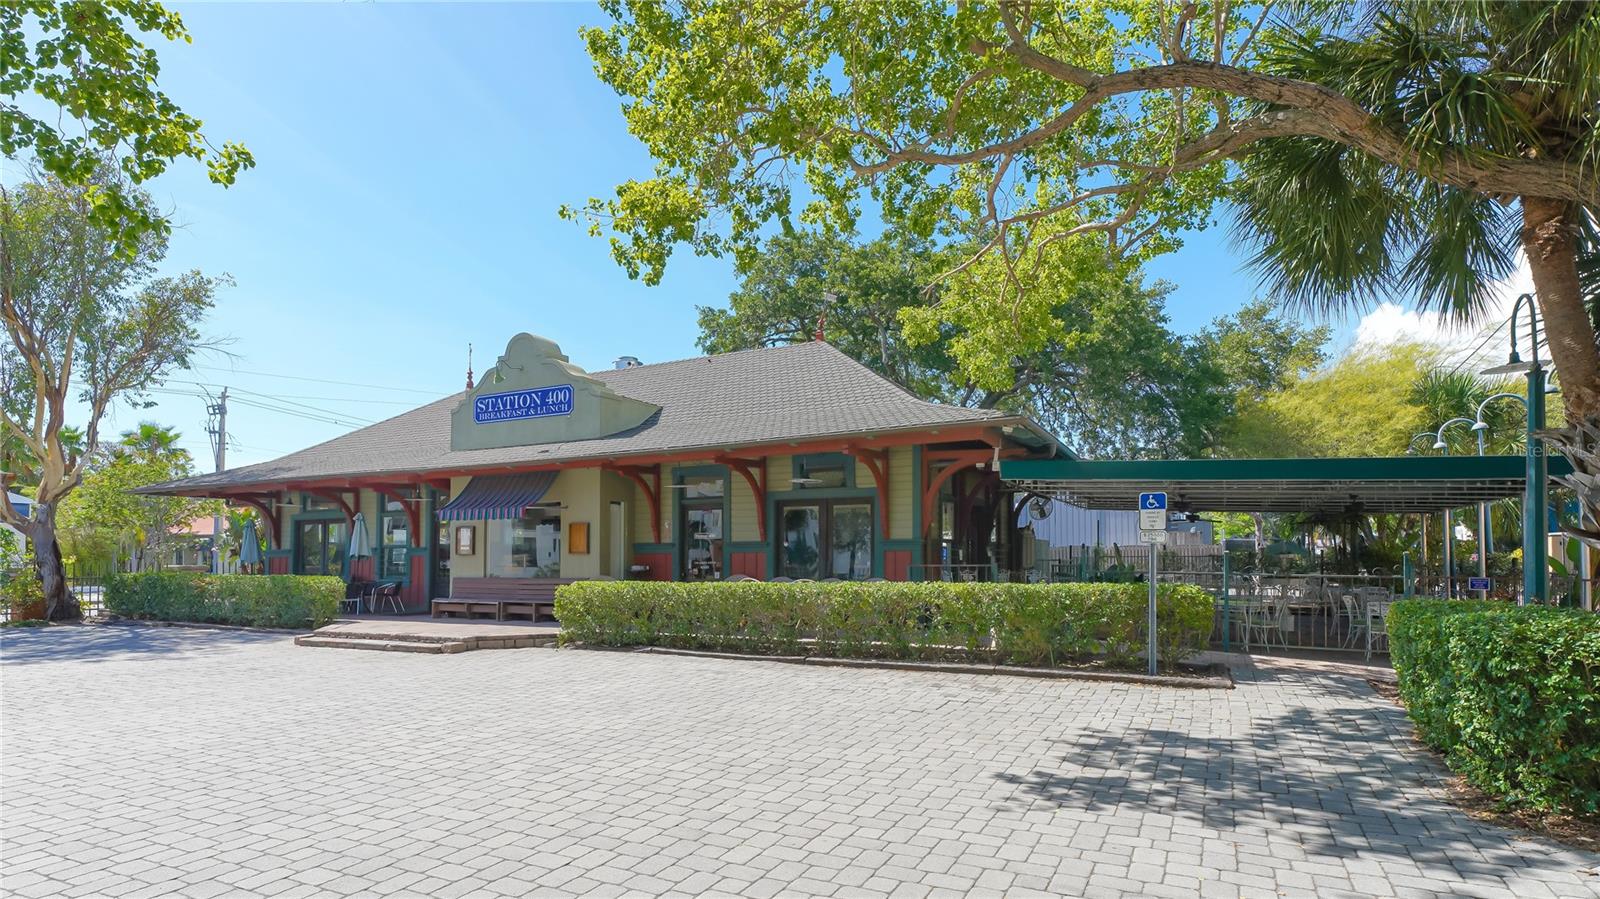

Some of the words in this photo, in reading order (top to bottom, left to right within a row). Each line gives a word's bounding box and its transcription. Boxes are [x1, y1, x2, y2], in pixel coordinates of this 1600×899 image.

[477, 392, 541, 412] STATION
[546, 389, 569, 405] 400
[479, 409, 527, 420] BREAKFAST
[537, 404, 568, 414] LUNCH
